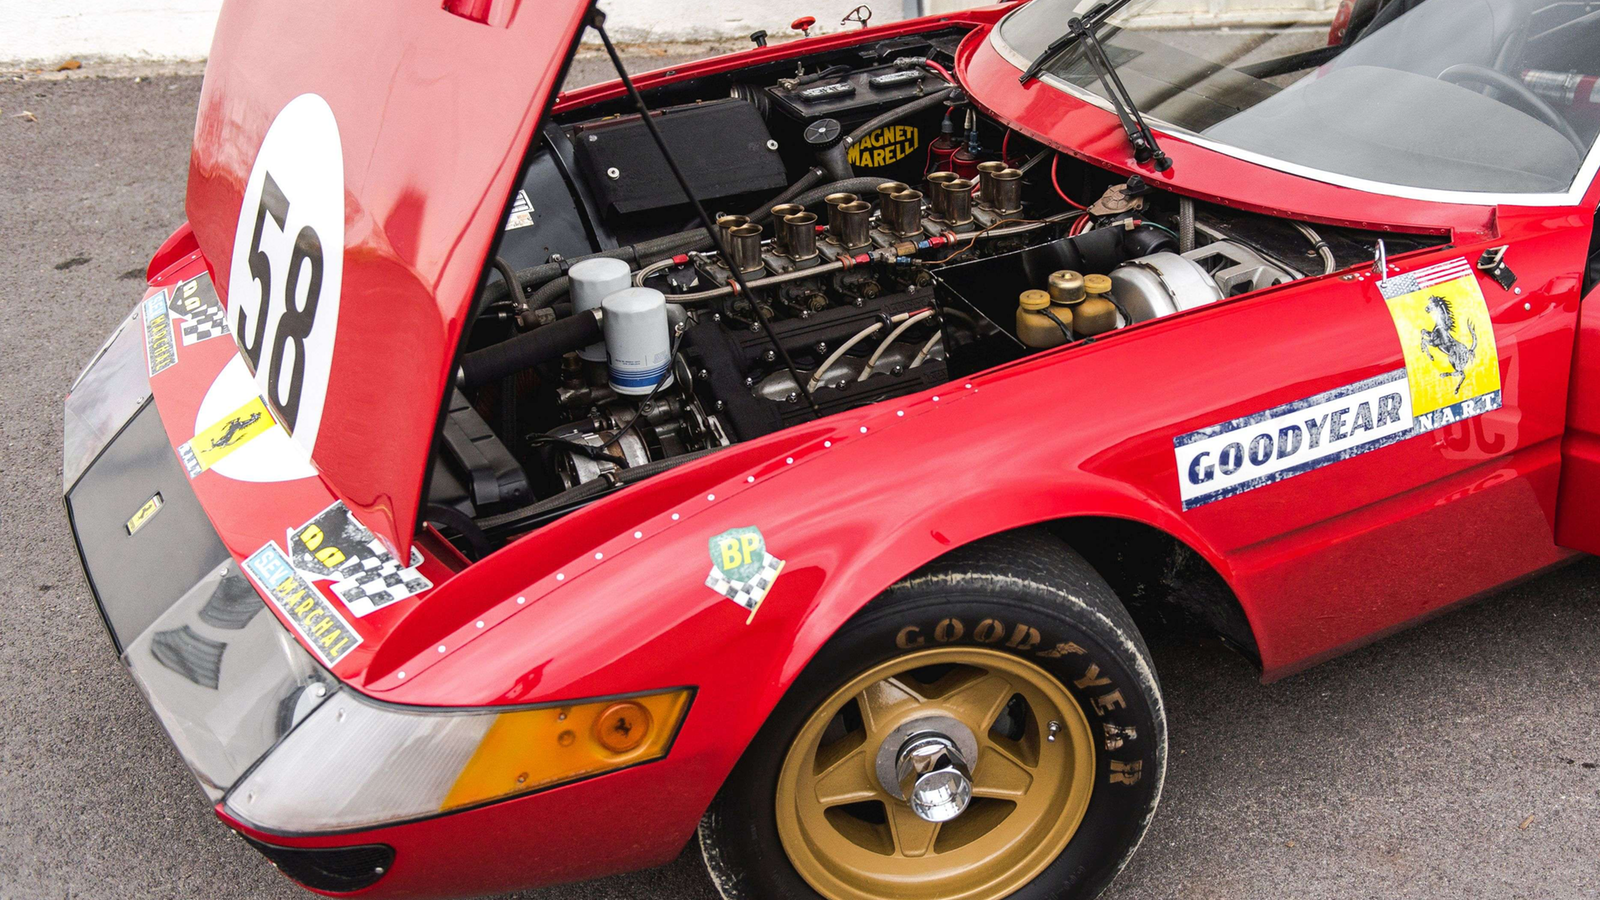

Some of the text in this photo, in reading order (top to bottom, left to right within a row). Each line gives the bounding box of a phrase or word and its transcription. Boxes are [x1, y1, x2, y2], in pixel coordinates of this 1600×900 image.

[847, 125, 919, 156] MAGNETI
[847, 141, 919, 167] MARELLI
[237, 169, 324, 438] 58
[150, 314, 171, 371] MARCHAL
[1419, 391, 1498, 433] N.A.R.T.
[1188, 392, 1403, 486] GOODYEAR
[718, 532, 760, 571] BP
[253, 550, 350, 657] SEV MARCHAL
